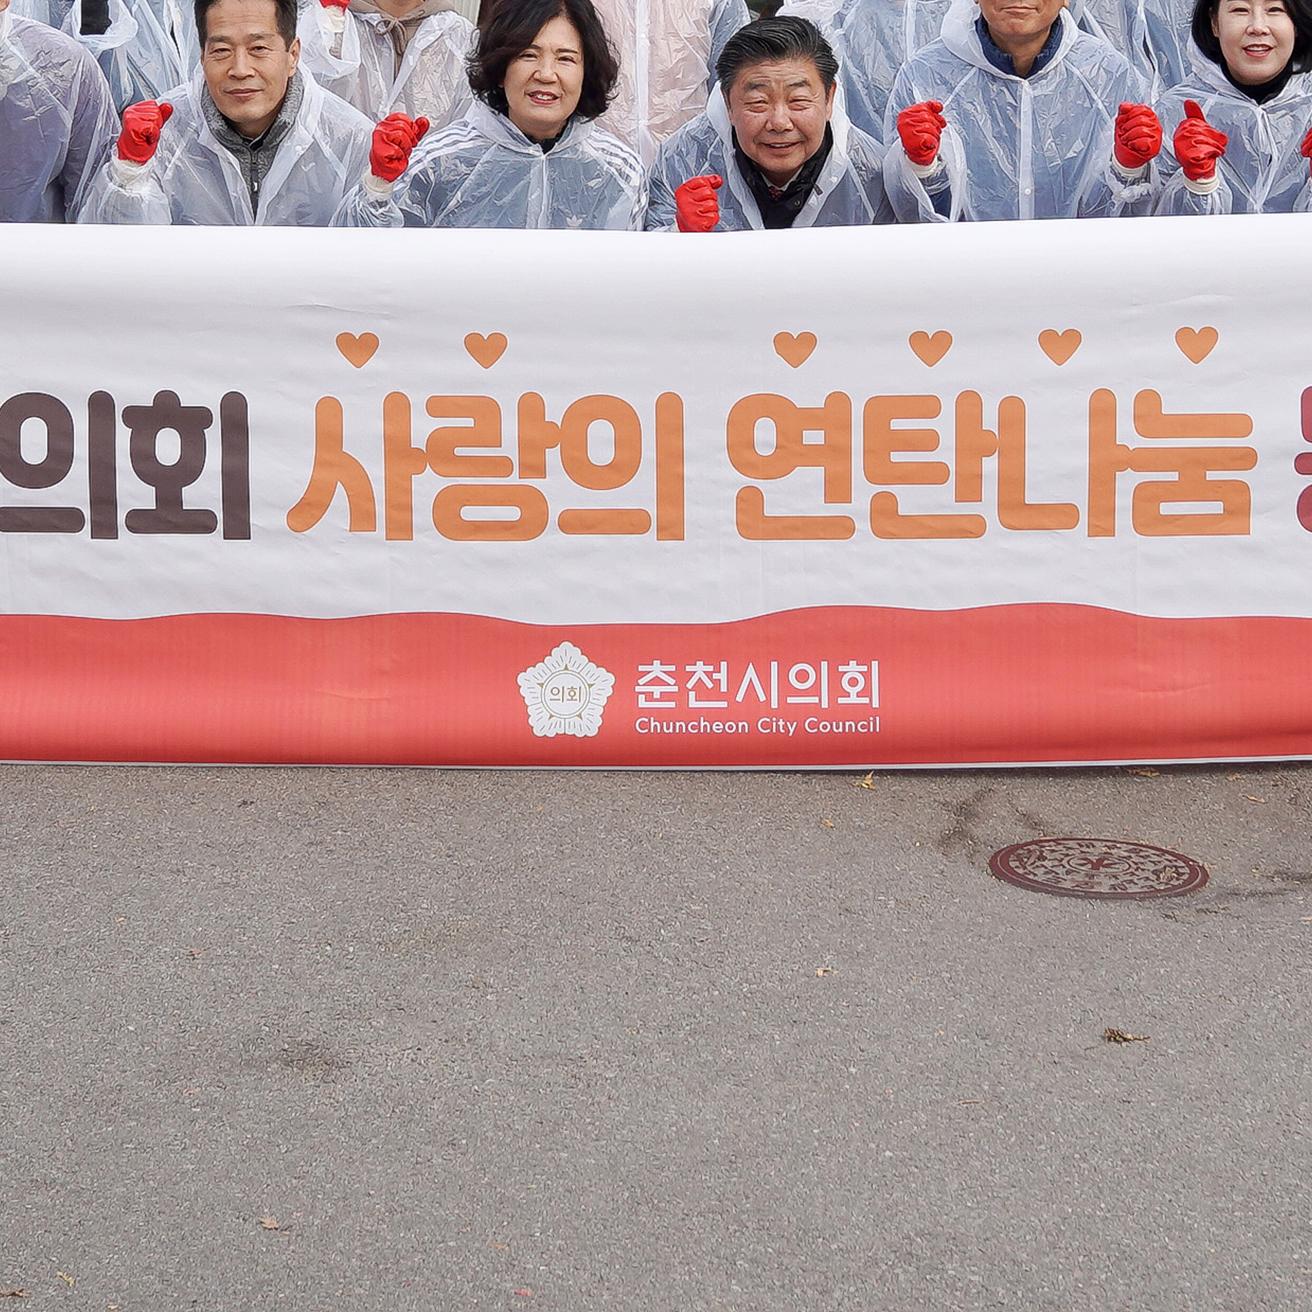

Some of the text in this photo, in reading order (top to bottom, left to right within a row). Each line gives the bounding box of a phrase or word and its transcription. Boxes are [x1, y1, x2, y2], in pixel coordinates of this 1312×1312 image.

[286, 390, 686, 542] 사랑의
[726, 387, 1258, 540] 연탄나눔
[549, 685, 582, 703] 의회
[634, 659, 880, 709] 춘천시의회
[635, 716, 880, 737] Chuncheon City Council
